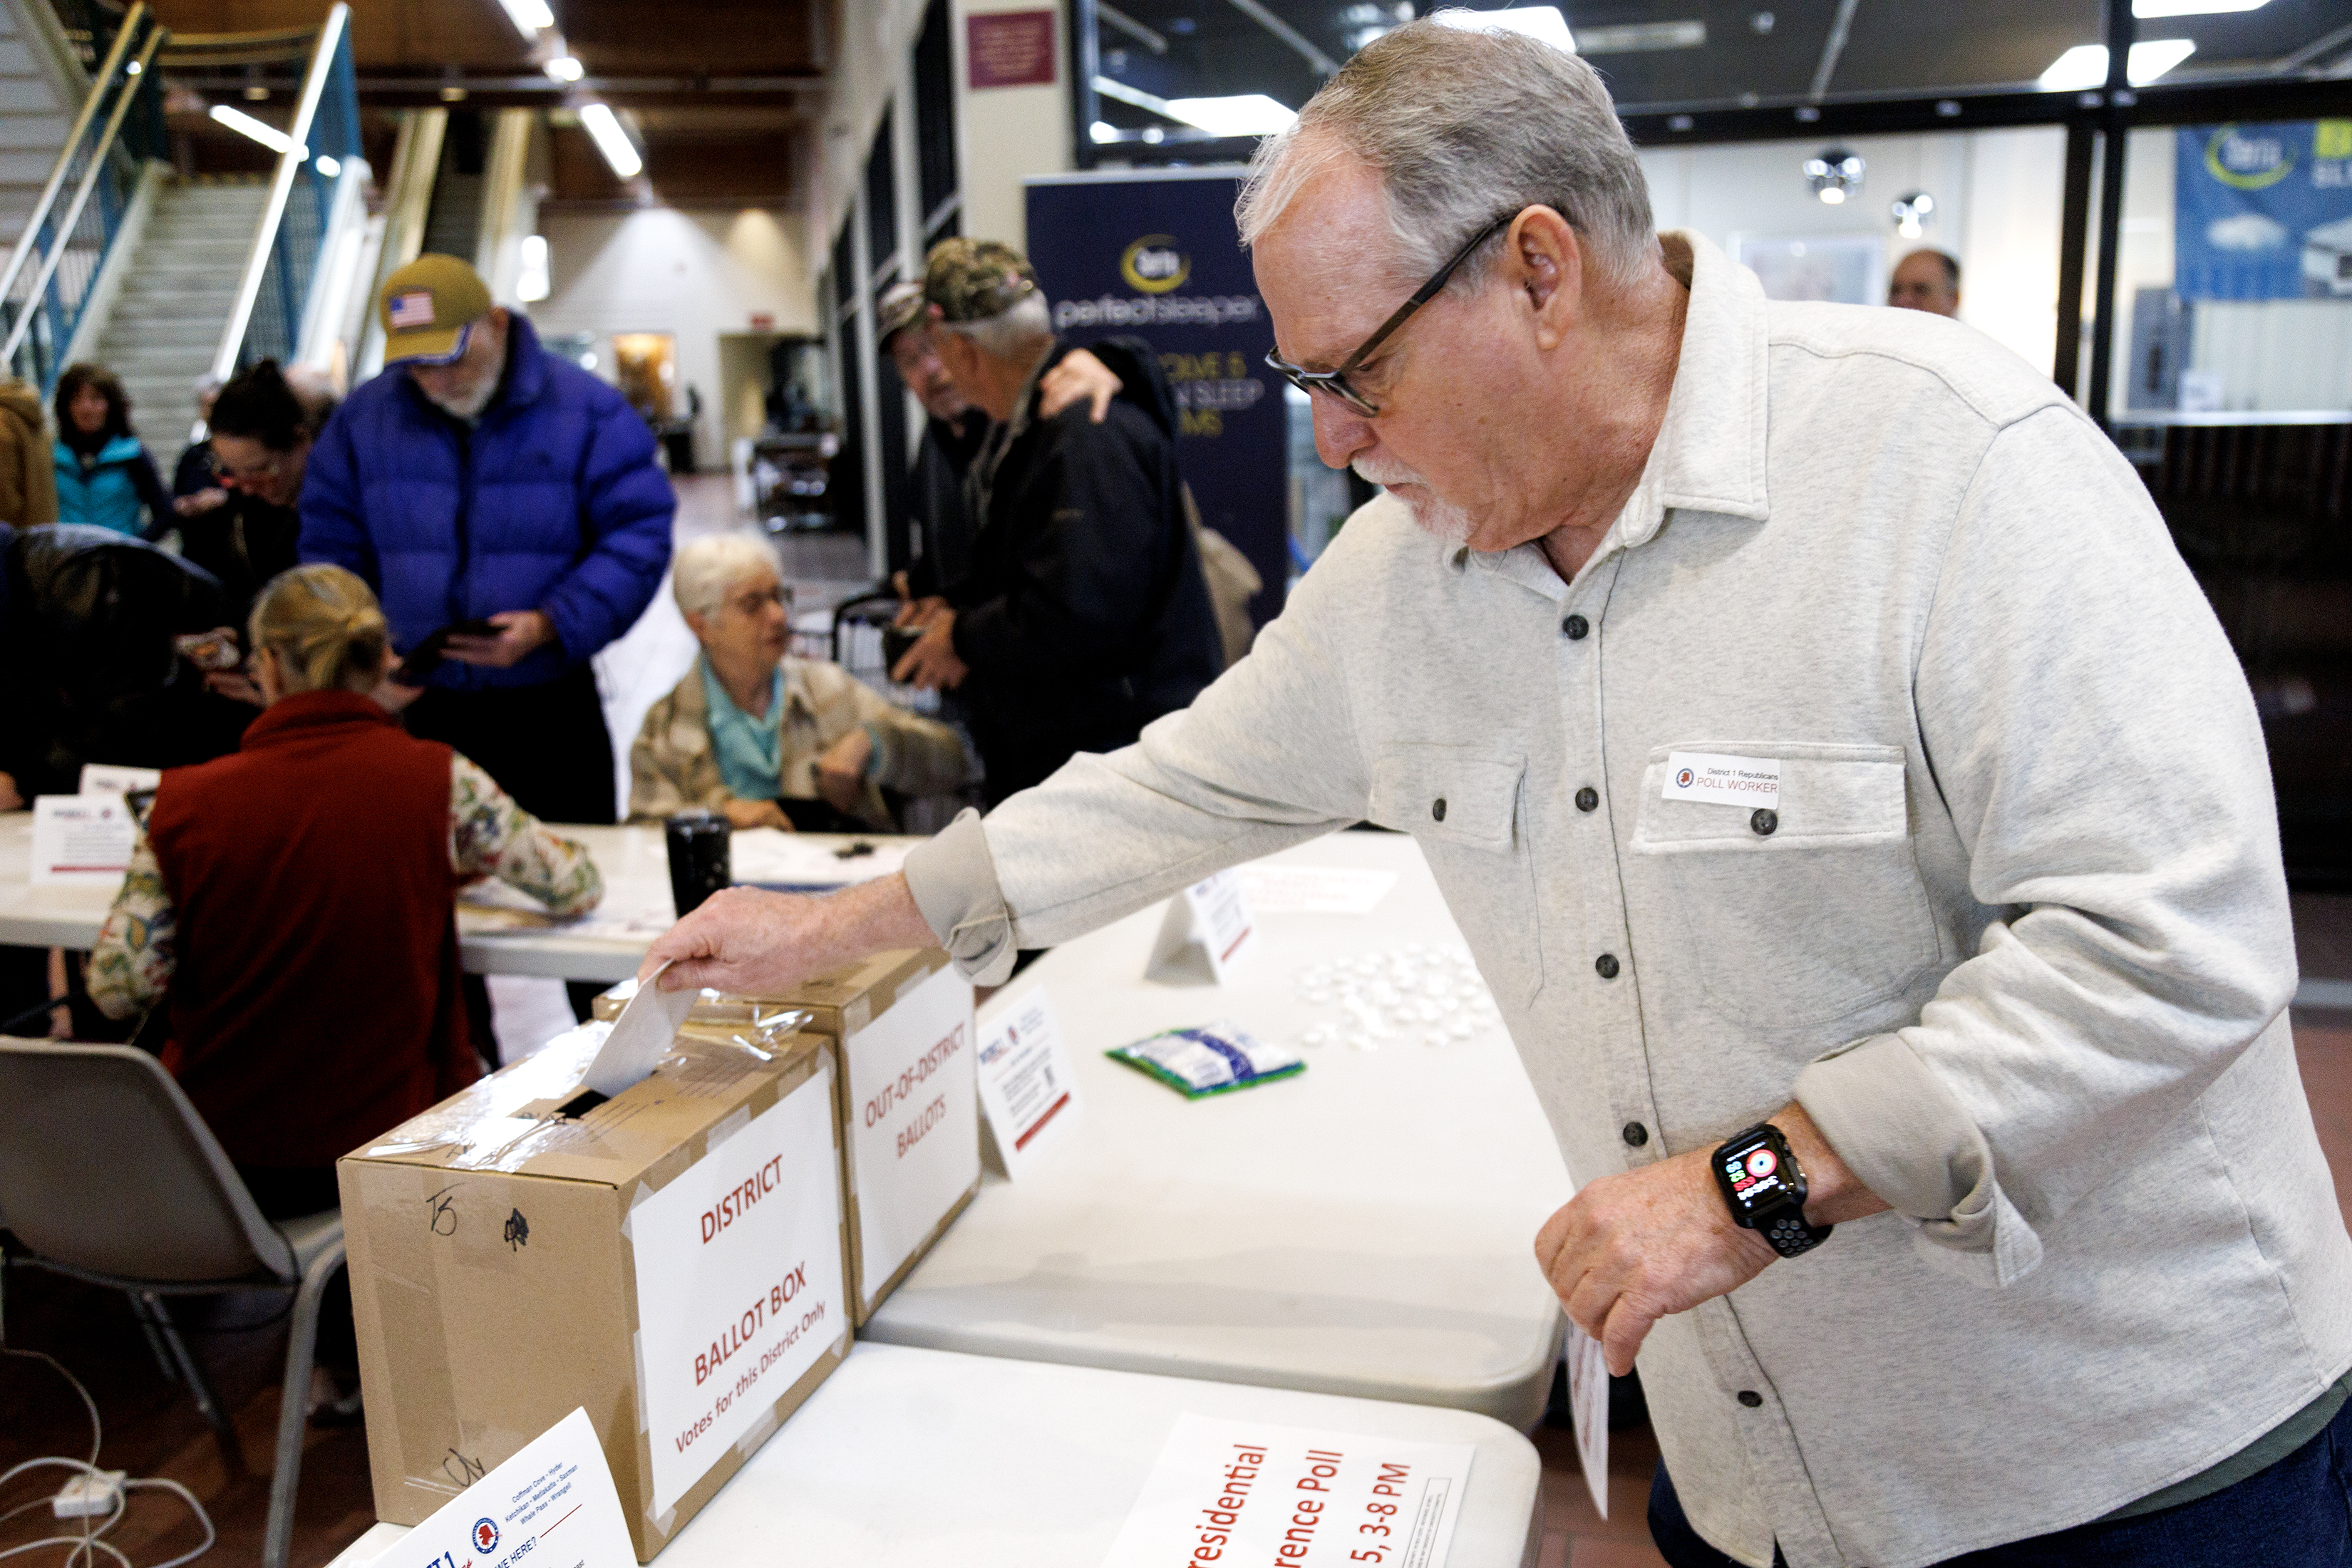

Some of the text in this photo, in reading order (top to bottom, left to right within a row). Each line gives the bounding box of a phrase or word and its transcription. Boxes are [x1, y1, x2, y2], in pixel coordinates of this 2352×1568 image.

[1696, 777, 1778, 793] POLL WORKER
[1707, 768, 1730, 776] District
[1738, 770, 1778, 780] Republicans
[865, 1021, 964, 1128] OUT-OF-DISTRICT
[897, 1093, 946, 1159] BALLOTS
[701, 1154, 783, 1244] DISTRICT
[694, 1261, 806, 1386] BALLOT BOX
[676, 1301, 826, 1453] Votes for this District Only
[512, 1462, 563, 1504] Coffman Cove Hyder
[1296, 1449, 1343, 1492] Poll
[1373, 1463, 1411, 1497] PM
[505, 1465, 579, 1524] Ketchikan Metlakatla Saxman
[520, 1481, 572, 1525] Whale Pass Wrangell
[1187, 1444, 1269, 1568] residential
[1359, 1502, 1398, 1537] 3-8
[510, 1535, 537, 1565] HERE?
